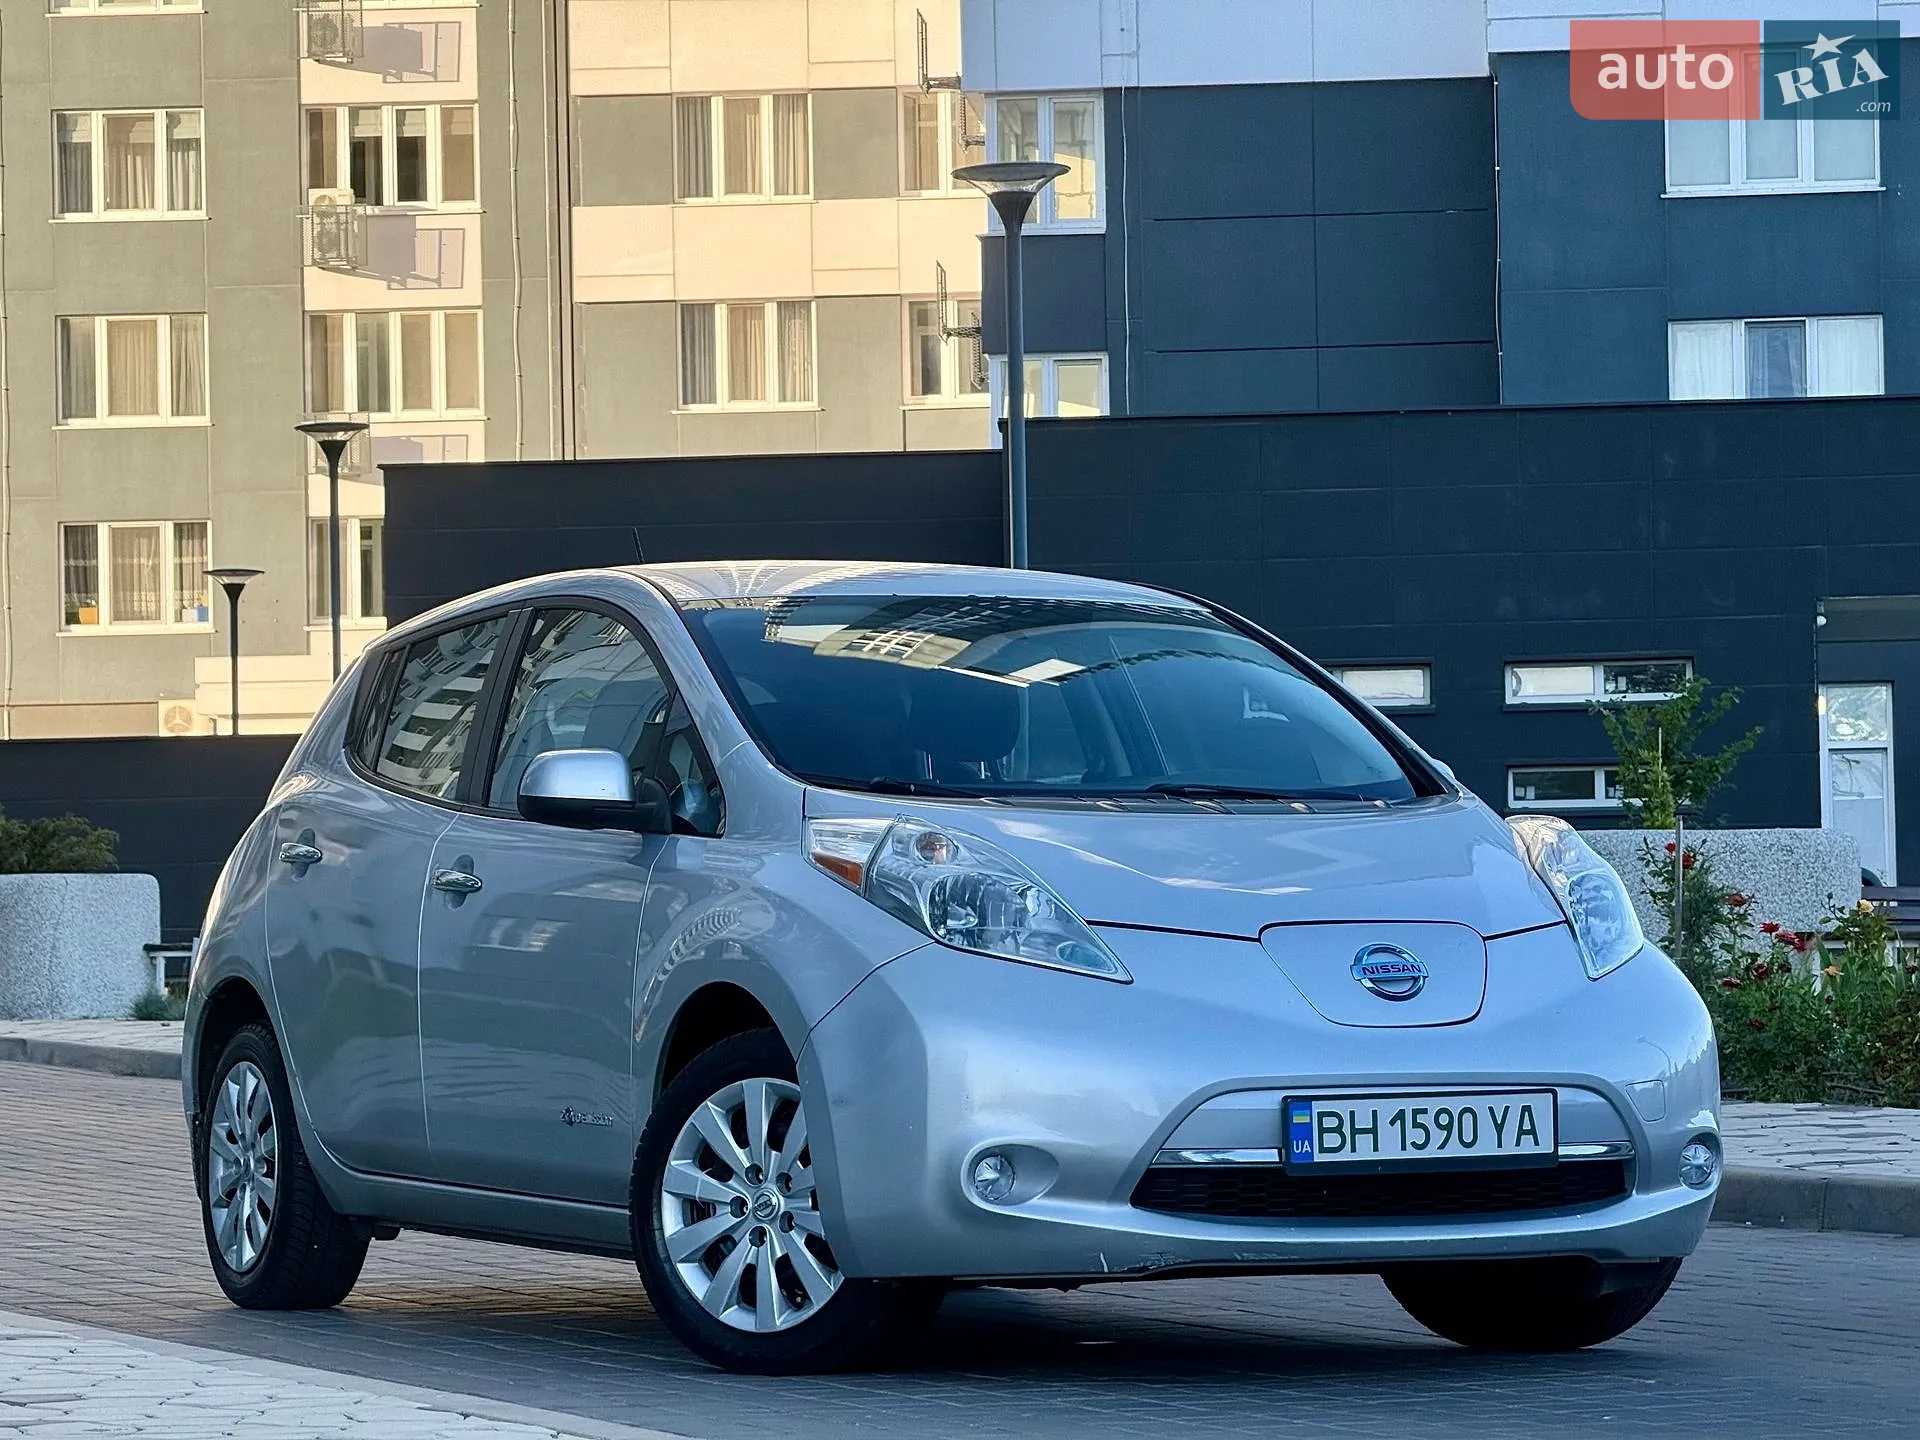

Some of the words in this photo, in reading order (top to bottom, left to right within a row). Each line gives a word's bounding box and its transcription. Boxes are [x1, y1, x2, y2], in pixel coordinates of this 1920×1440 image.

[1361, 964, 1422, 976] NISSAN
[1316, 1109, 1380, 1154] BH
[1388, 1106, 1478, 1152] 1590
[1487, 1104, 1540, 1149] YA
[1293, 1139, 1312, 1154] UA
